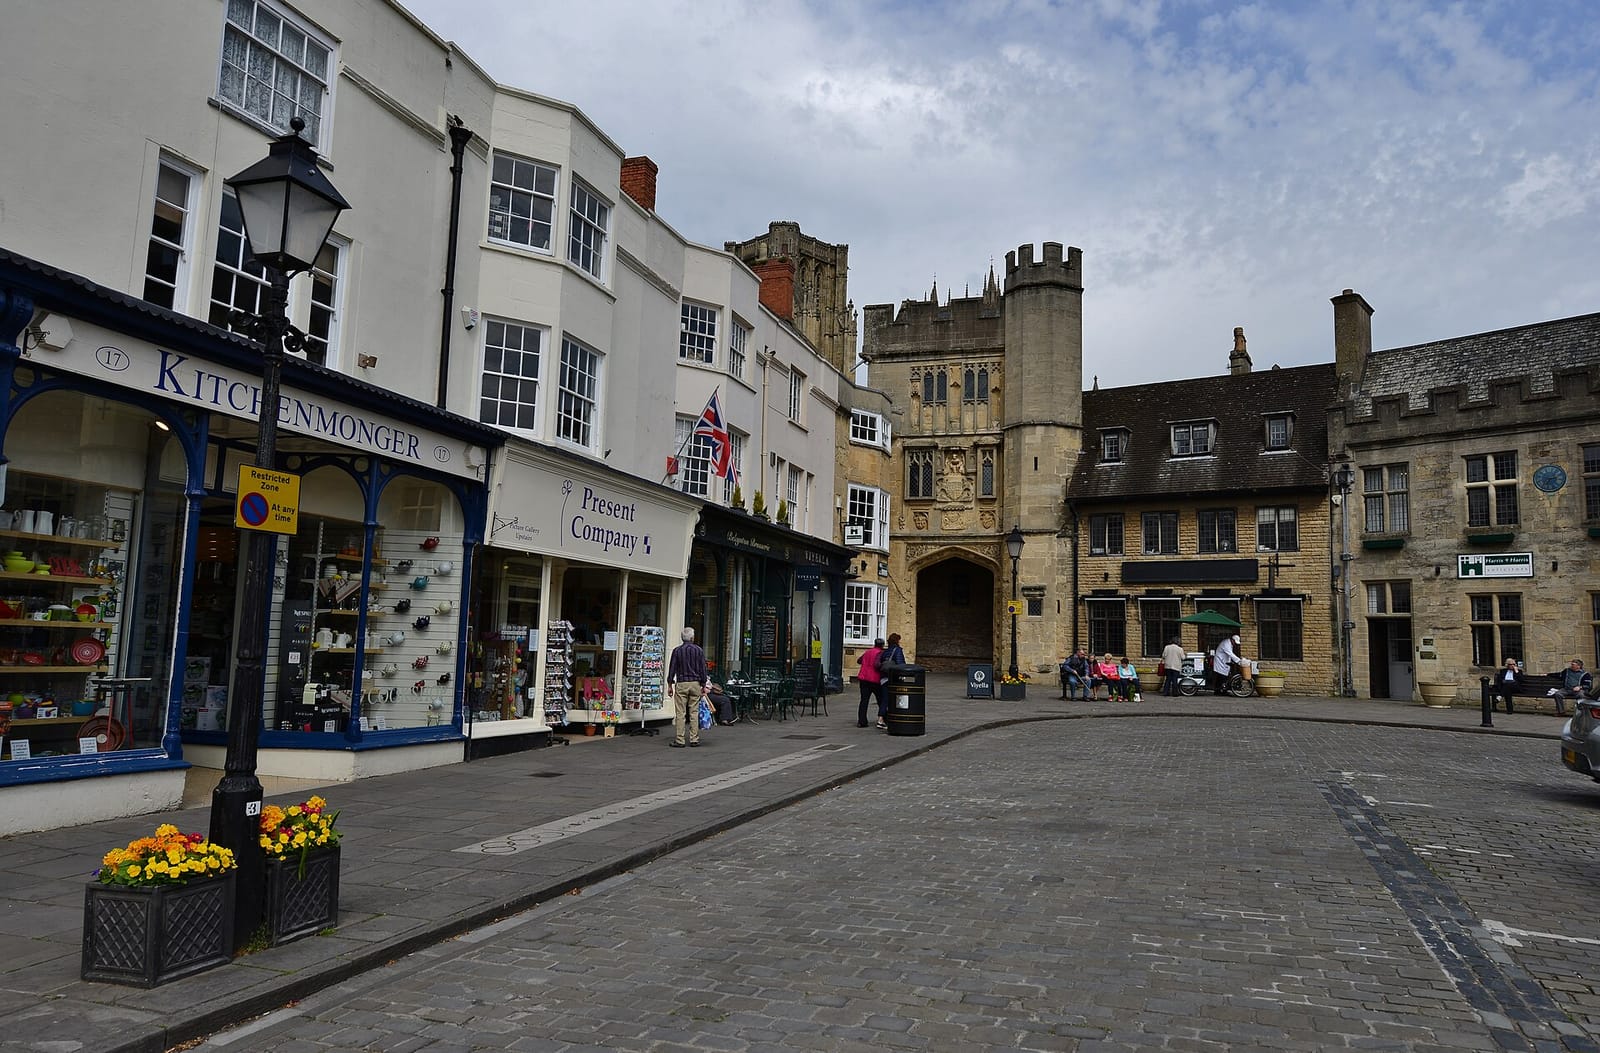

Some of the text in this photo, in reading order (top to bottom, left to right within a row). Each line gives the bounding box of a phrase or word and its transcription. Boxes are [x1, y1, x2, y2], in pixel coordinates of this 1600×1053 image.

[105, 350, 121, 367] 17
[438, 449, 447, 460] 17
[251, 470, 290, 484] Restricted
[261, 481, 279, 492] Zone
[272, 504, 295, 514] At any
[582, 487, 635, 522] Present
[275, 513, 291, 522] time
[572, 515, 638, 556] Company
